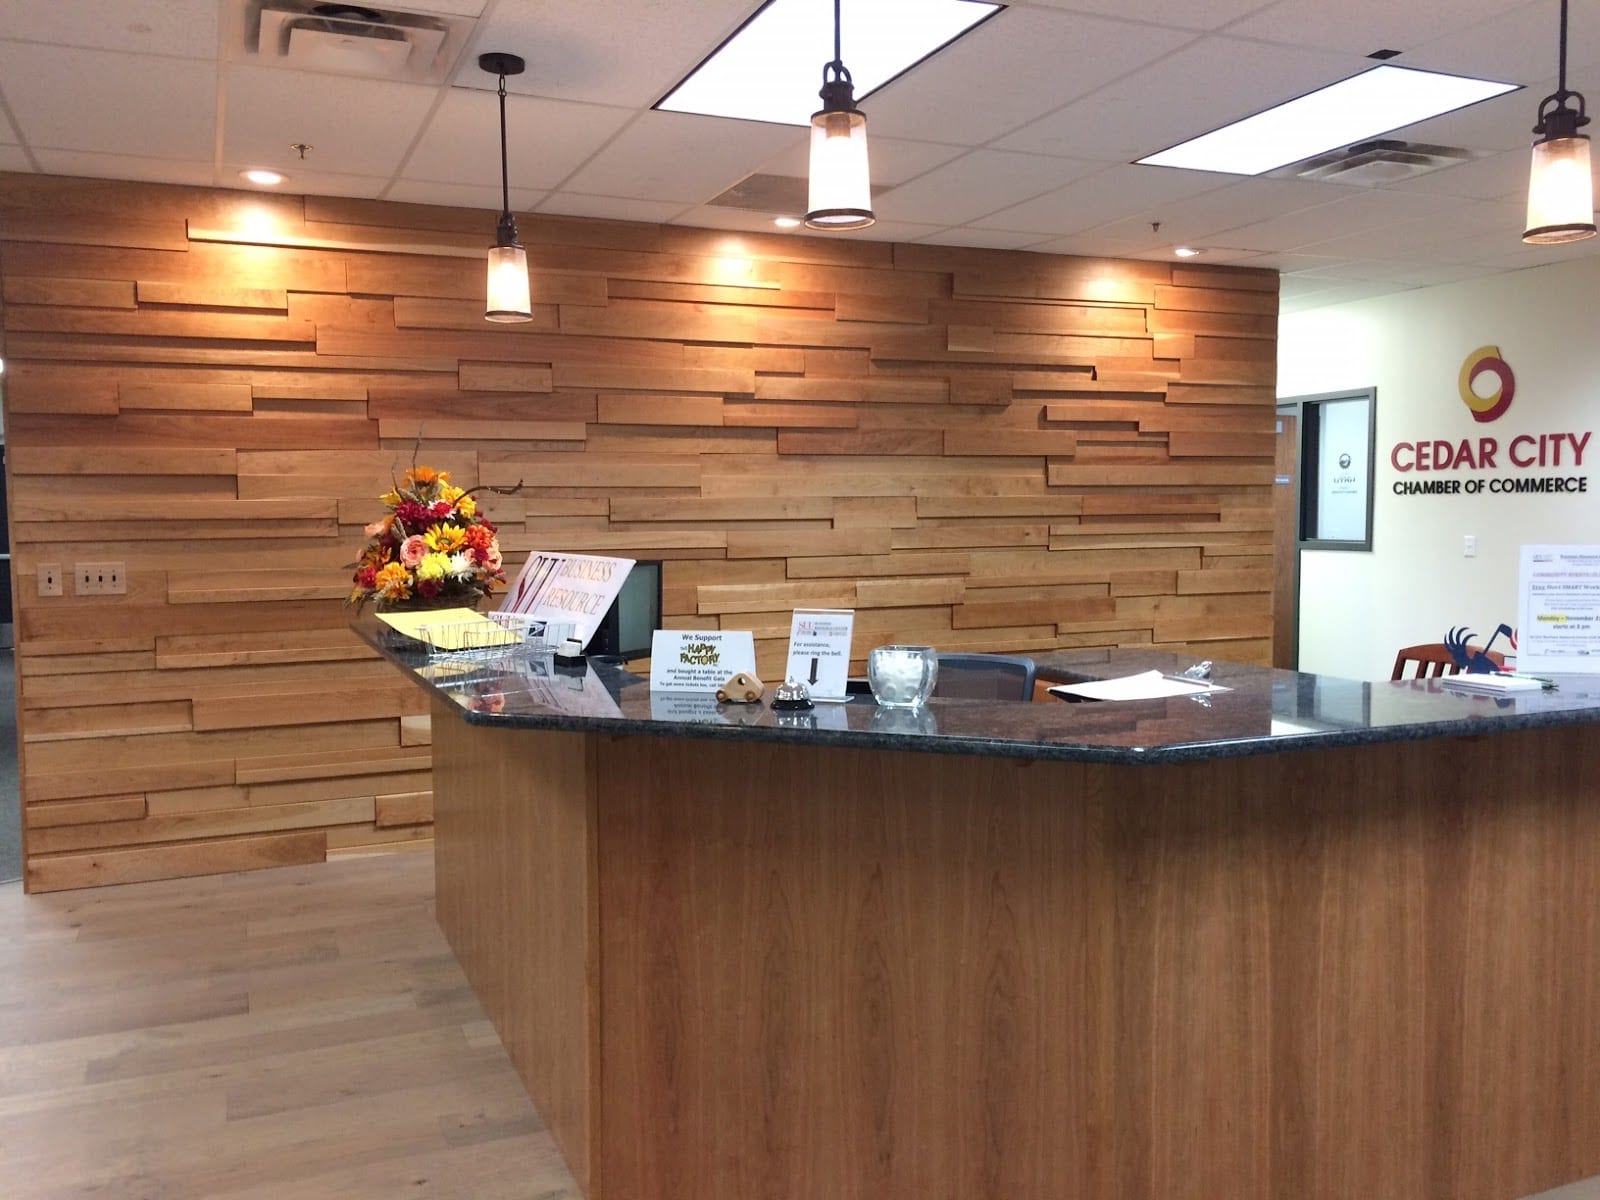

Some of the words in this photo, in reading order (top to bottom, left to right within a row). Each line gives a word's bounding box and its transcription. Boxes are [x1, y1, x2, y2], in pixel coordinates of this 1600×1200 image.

[1391, 437, 1498, 472] CEDAR
[1509, 432, 1592, 467] CITY
[1393, 480, 1461, 495] CHAMBER
[1465, 479, 1486, 493] OF
[1489, 477, 1587, 493] COMMERCE
[560, 558, 616, 583] BUSINESS
[542, 587, 605, 615] RESOURCE
[694, 634, 722, 642] Support
[688, 643, 716, 655] HAPPY
[680, 653, 720, 666] FACTORY
